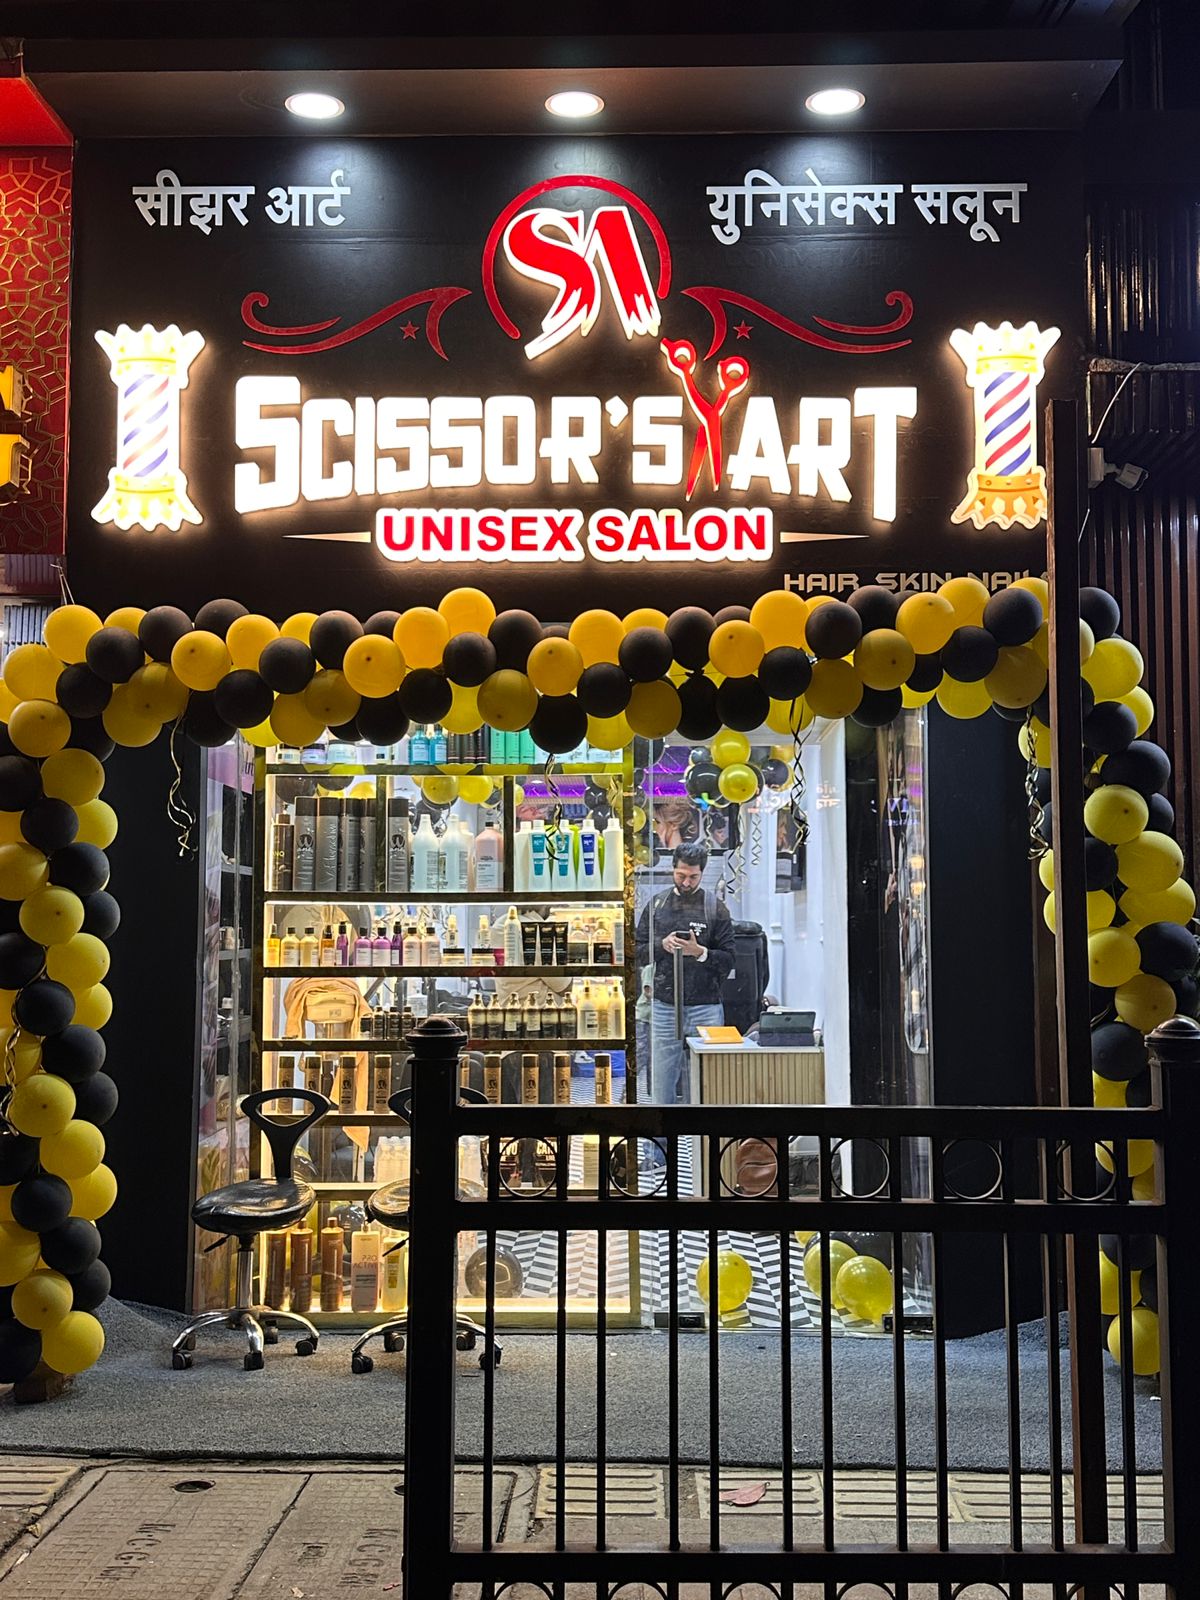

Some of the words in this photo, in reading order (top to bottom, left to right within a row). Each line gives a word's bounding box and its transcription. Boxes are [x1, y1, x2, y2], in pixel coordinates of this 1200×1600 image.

[132, 169, 256, 235] सीझर
[264, 170, 351, 228] आर्ट
[705, 168, 903, 246] युनिसेक्स
[911, 182, 1028, 244] सलून
[234, 375, 684, 514] SCISSOR'S
[726, 386, 919, 522] ART
[383, 515, 577, 552] UNISEX
[594, 514, 767, 552] SALON
[784, 573, 860, 593] HAIR
[875, 572, 952, 592] SKIN
